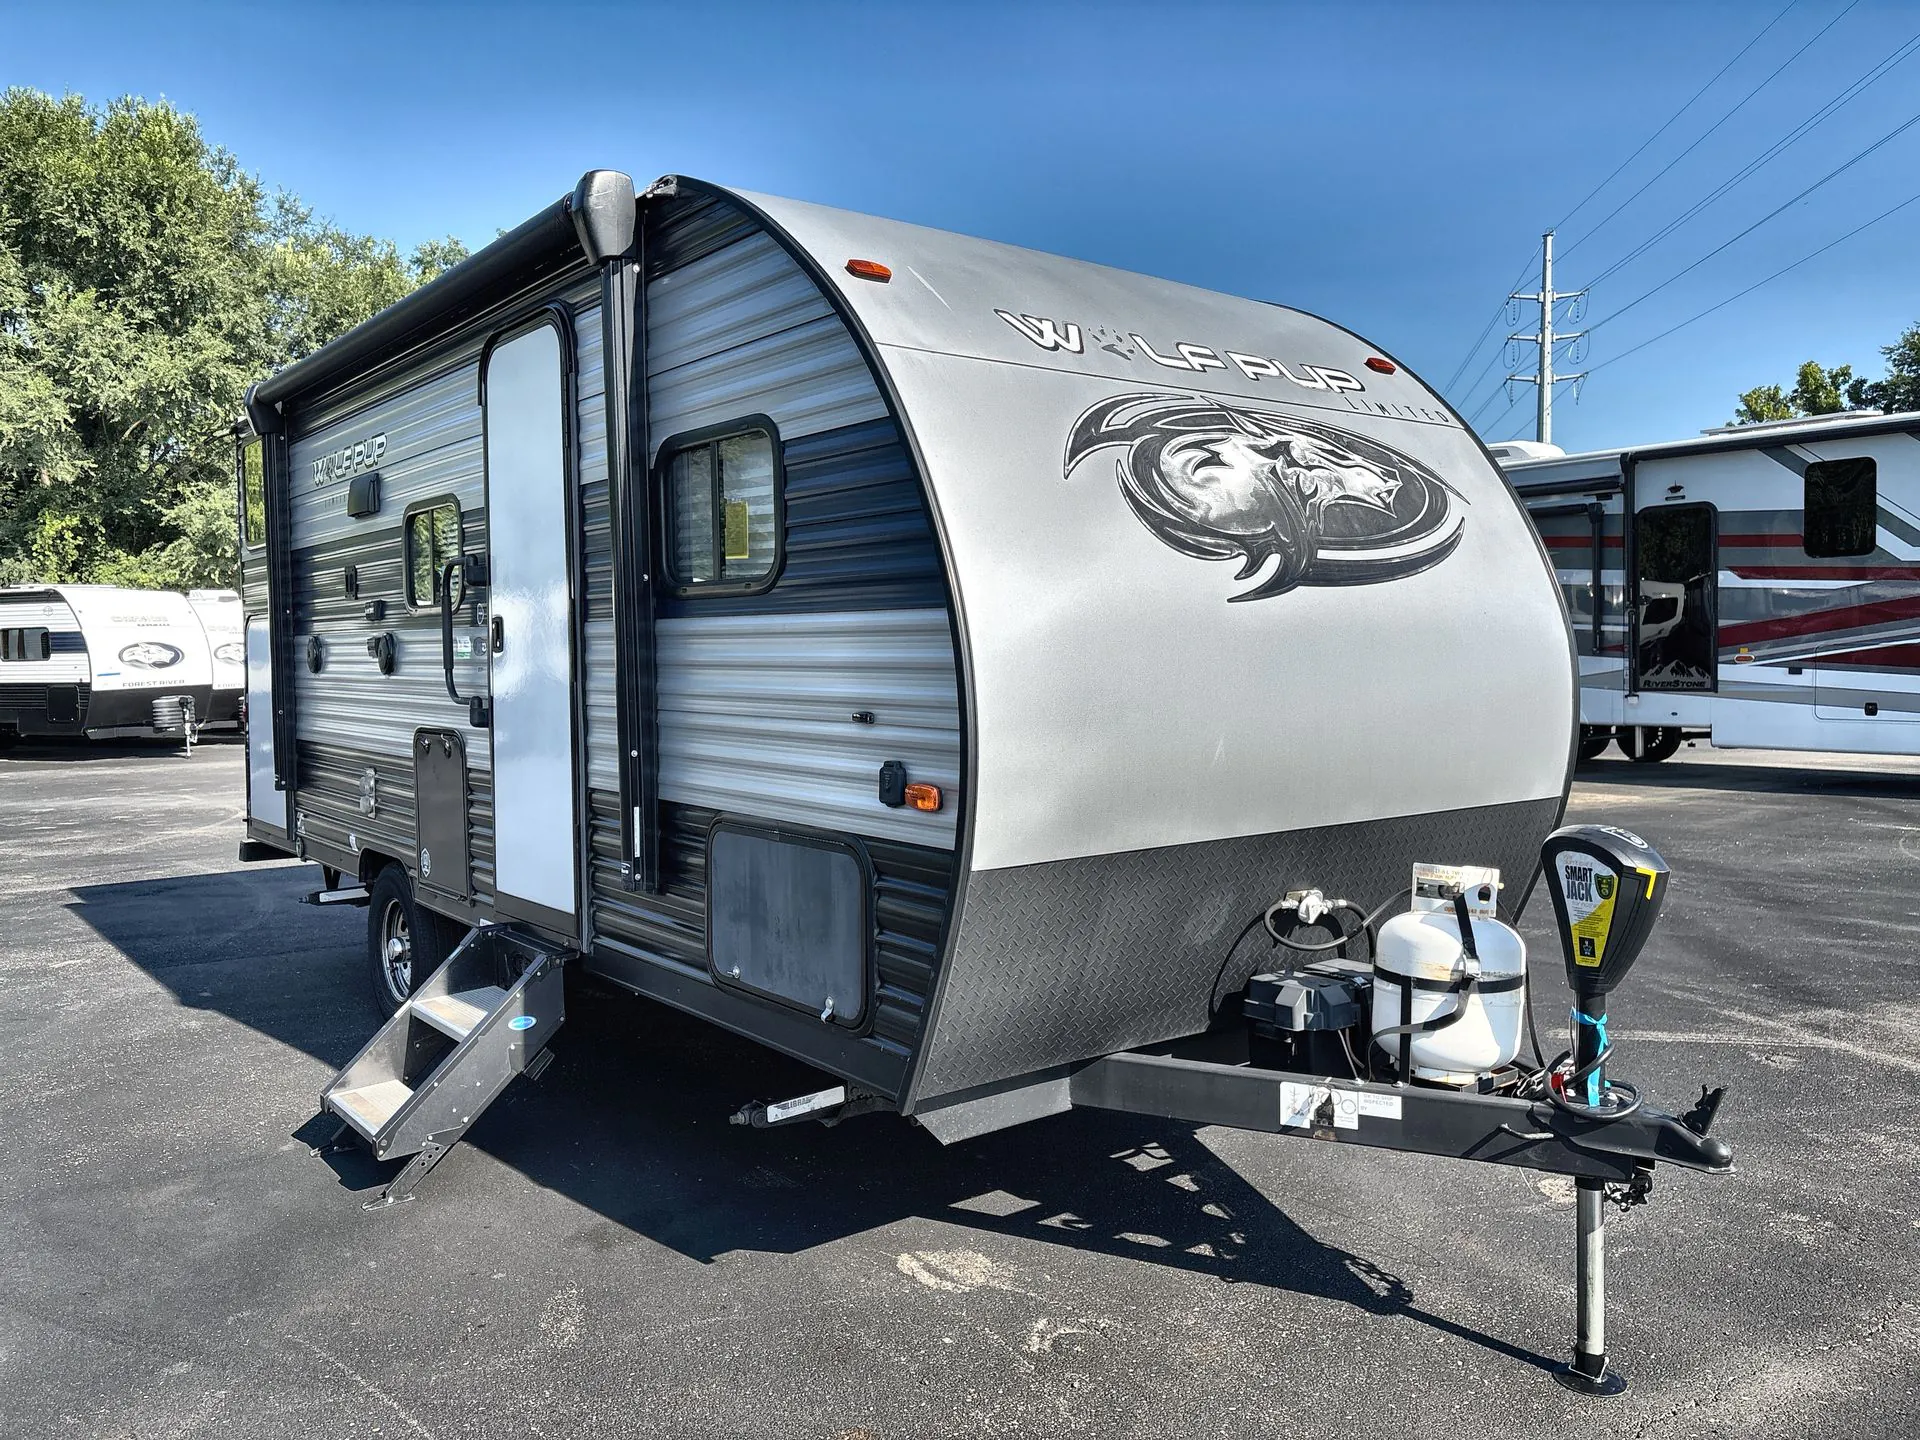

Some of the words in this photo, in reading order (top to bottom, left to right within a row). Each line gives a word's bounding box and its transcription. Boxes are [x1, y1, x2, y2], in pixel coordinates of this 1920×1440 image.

[1226, 350, 1366, 394] PUP
[1343, 396, 1449, 424] LIMITED
[353, 432, 388, 473] PUP
[122, 680, 158, 688] FOREST
[1564, 865, 1593, 882] SMART
[1566, 880, 1593, 903] JACK
